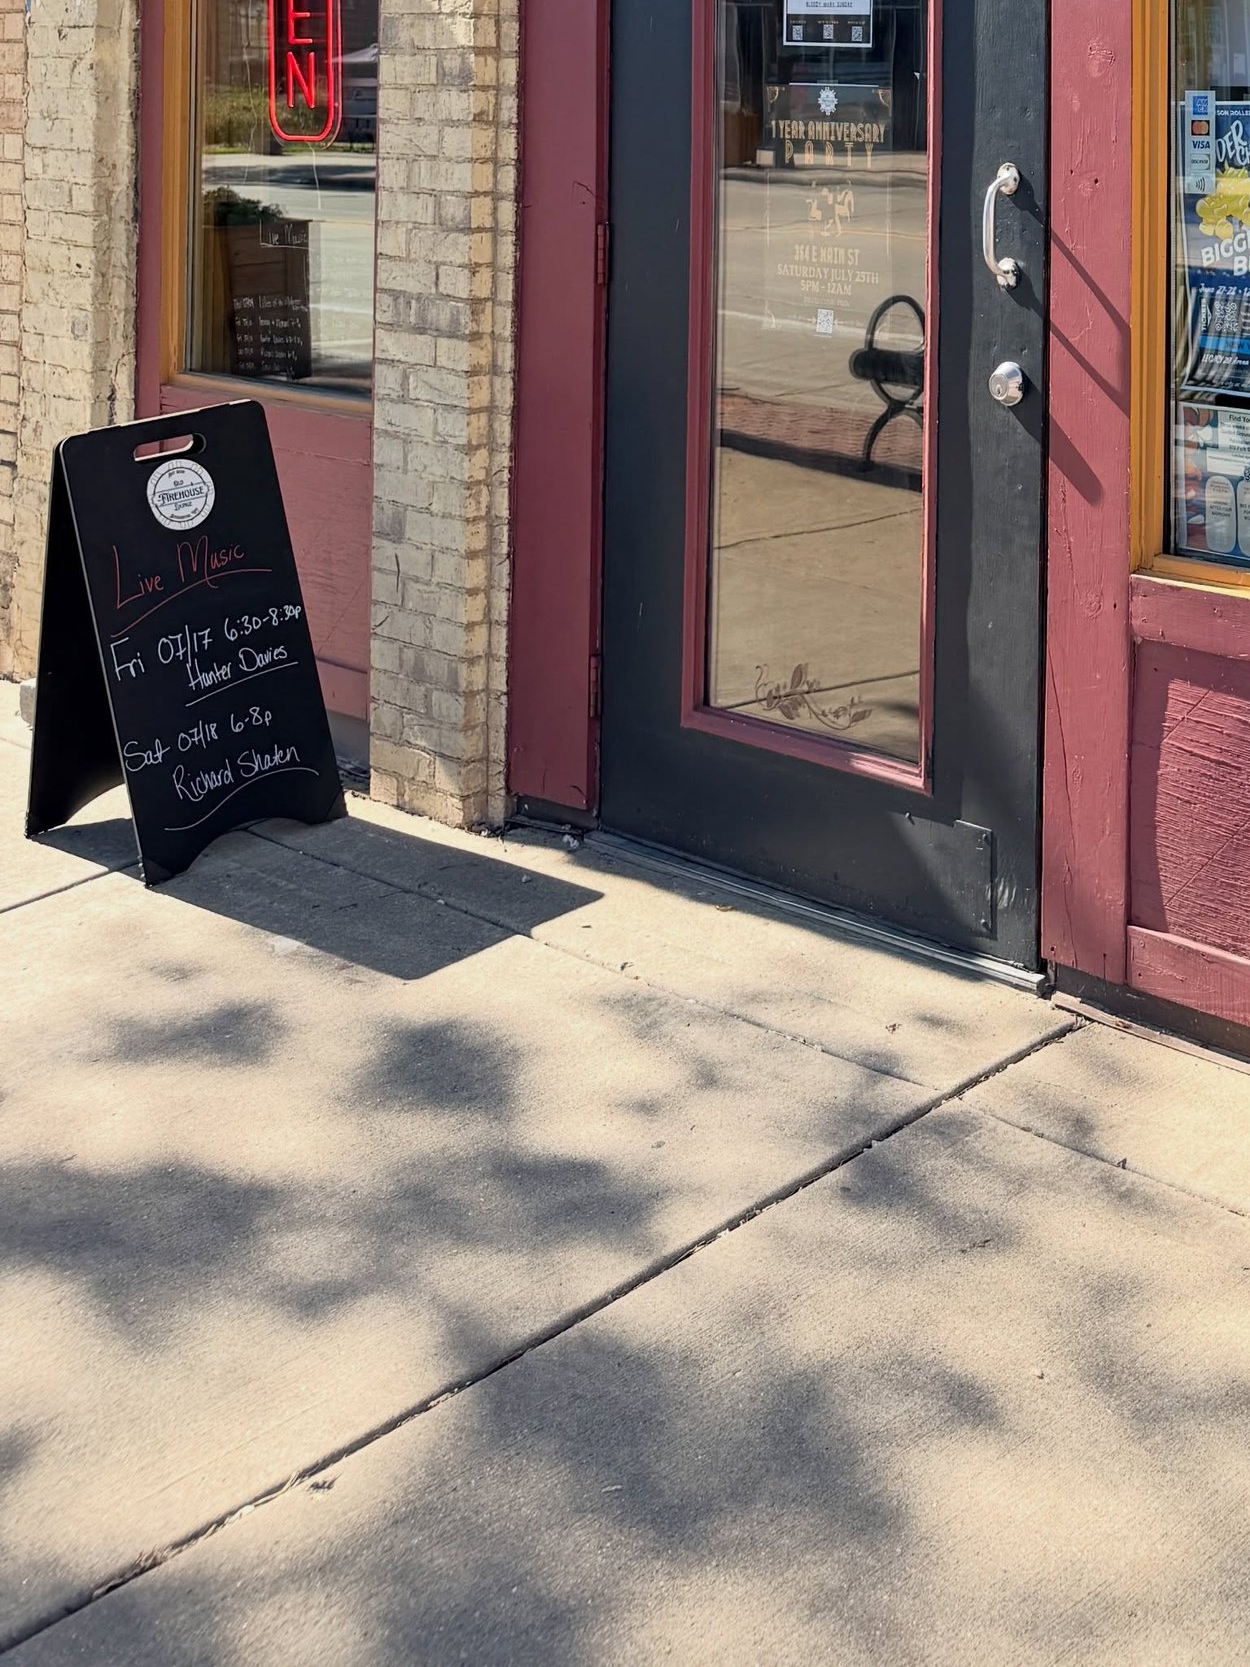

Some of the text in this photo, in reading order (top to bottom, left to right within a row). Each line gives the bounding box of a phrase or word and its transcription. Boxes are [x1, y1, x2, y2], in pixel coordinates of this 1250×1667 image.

[771, 120, 885, 143] 1 YEAR ANNIVERSARY
[785, 139, 874, 169] PARTY
[1192, 140, 1210, 149] VISA
[848, 248, 860, 266] ST
[777, 264, 879, 284] SATURDAY JULY 25TH
[800, 280, 851, 295] 5PM 12AM
[1215, 286, 1236, 296] 27-28
[1225, 341, 1245, 349] NEW
[113, 535, 244, 609] Live Music
[110, 604, 301, 681] Fri 07/17 6:30-8:30p
[187, 646, 287, 690] Hunter Davies
[124, 707, 272, 771] Sat 07/18 6-8p
[172, 759, 234, 801] Richard
